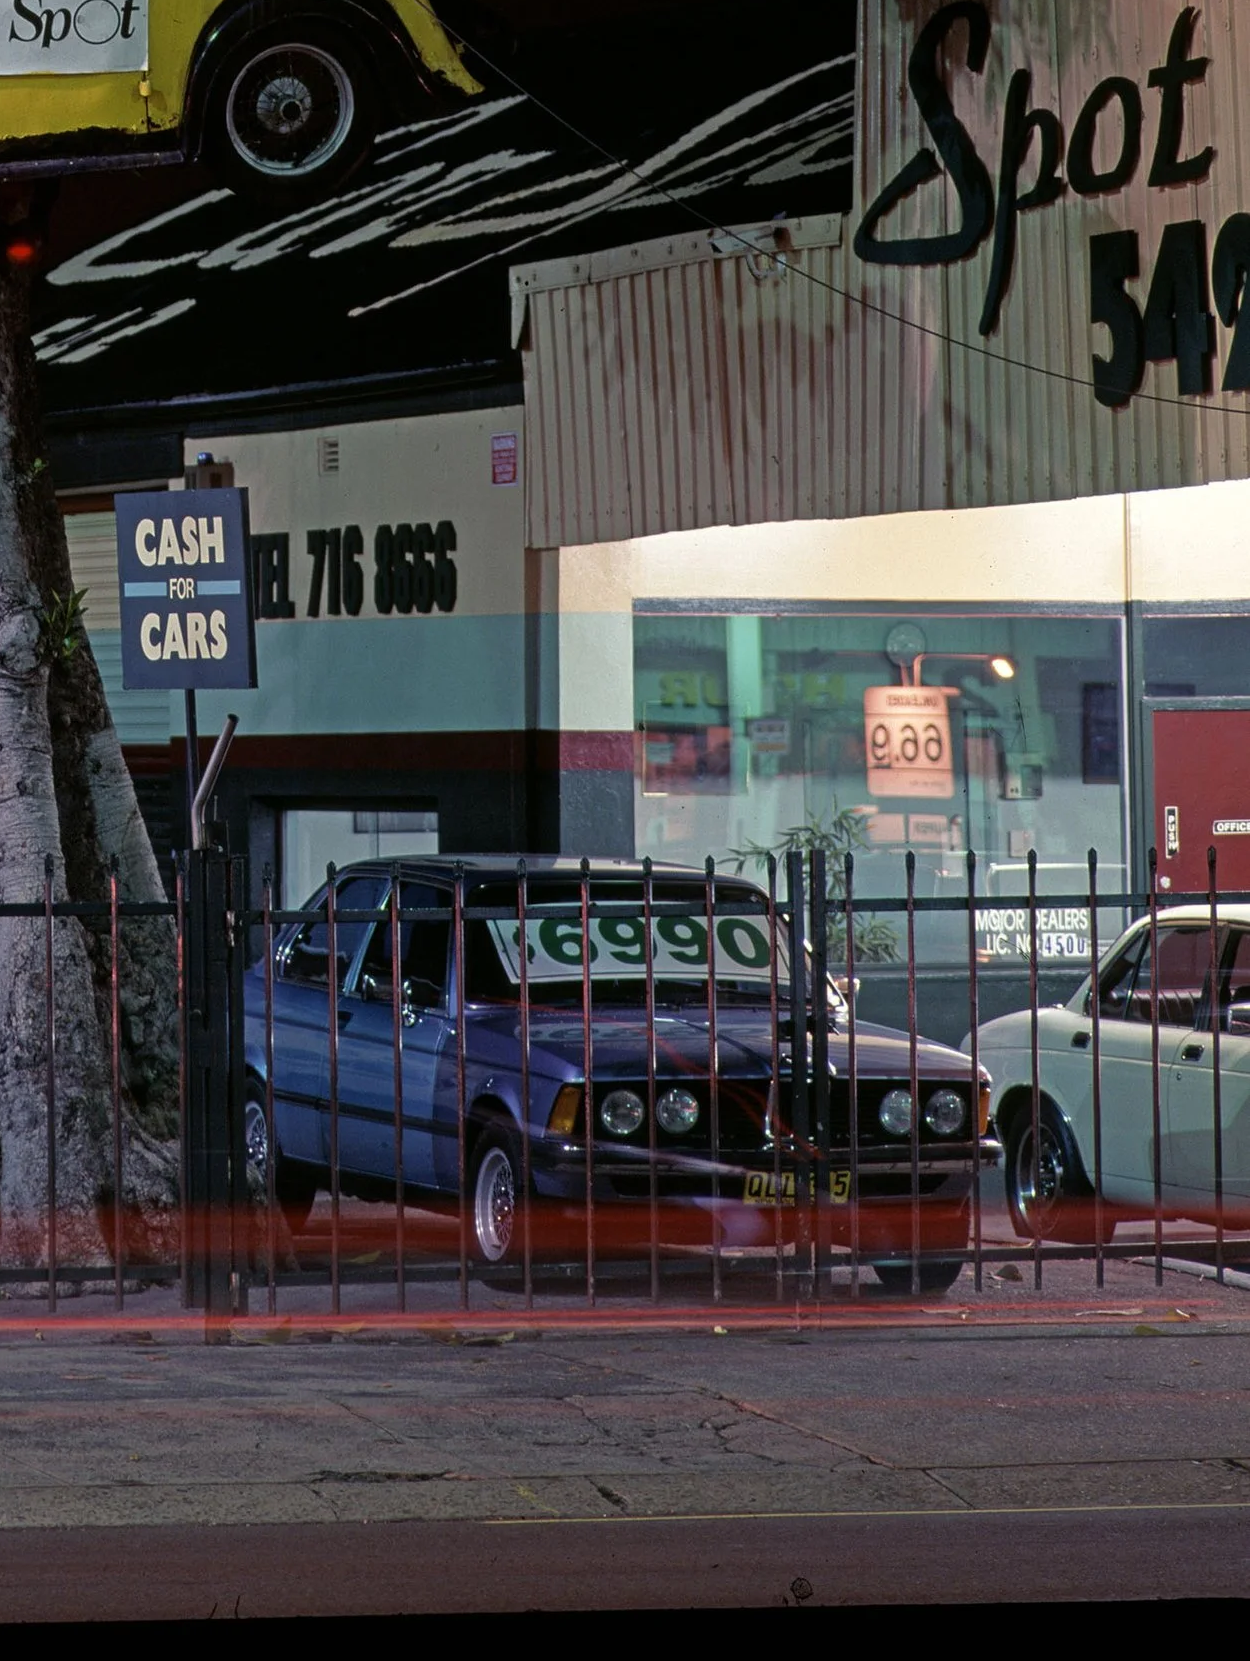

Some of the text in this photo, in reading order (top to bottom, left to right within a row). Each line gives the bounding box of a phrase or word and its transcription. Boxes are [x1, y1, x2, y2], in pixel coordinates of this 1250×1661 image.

[853, 0, 1217, 338] Spot
[135, 515, 225, 568] CASH
[170, 577, 195, 599] FOR
[306, 524, 364, 617] 716
[140, 609, 228, 661] CARS
[975, 909, 1025, 931] MOTOR
